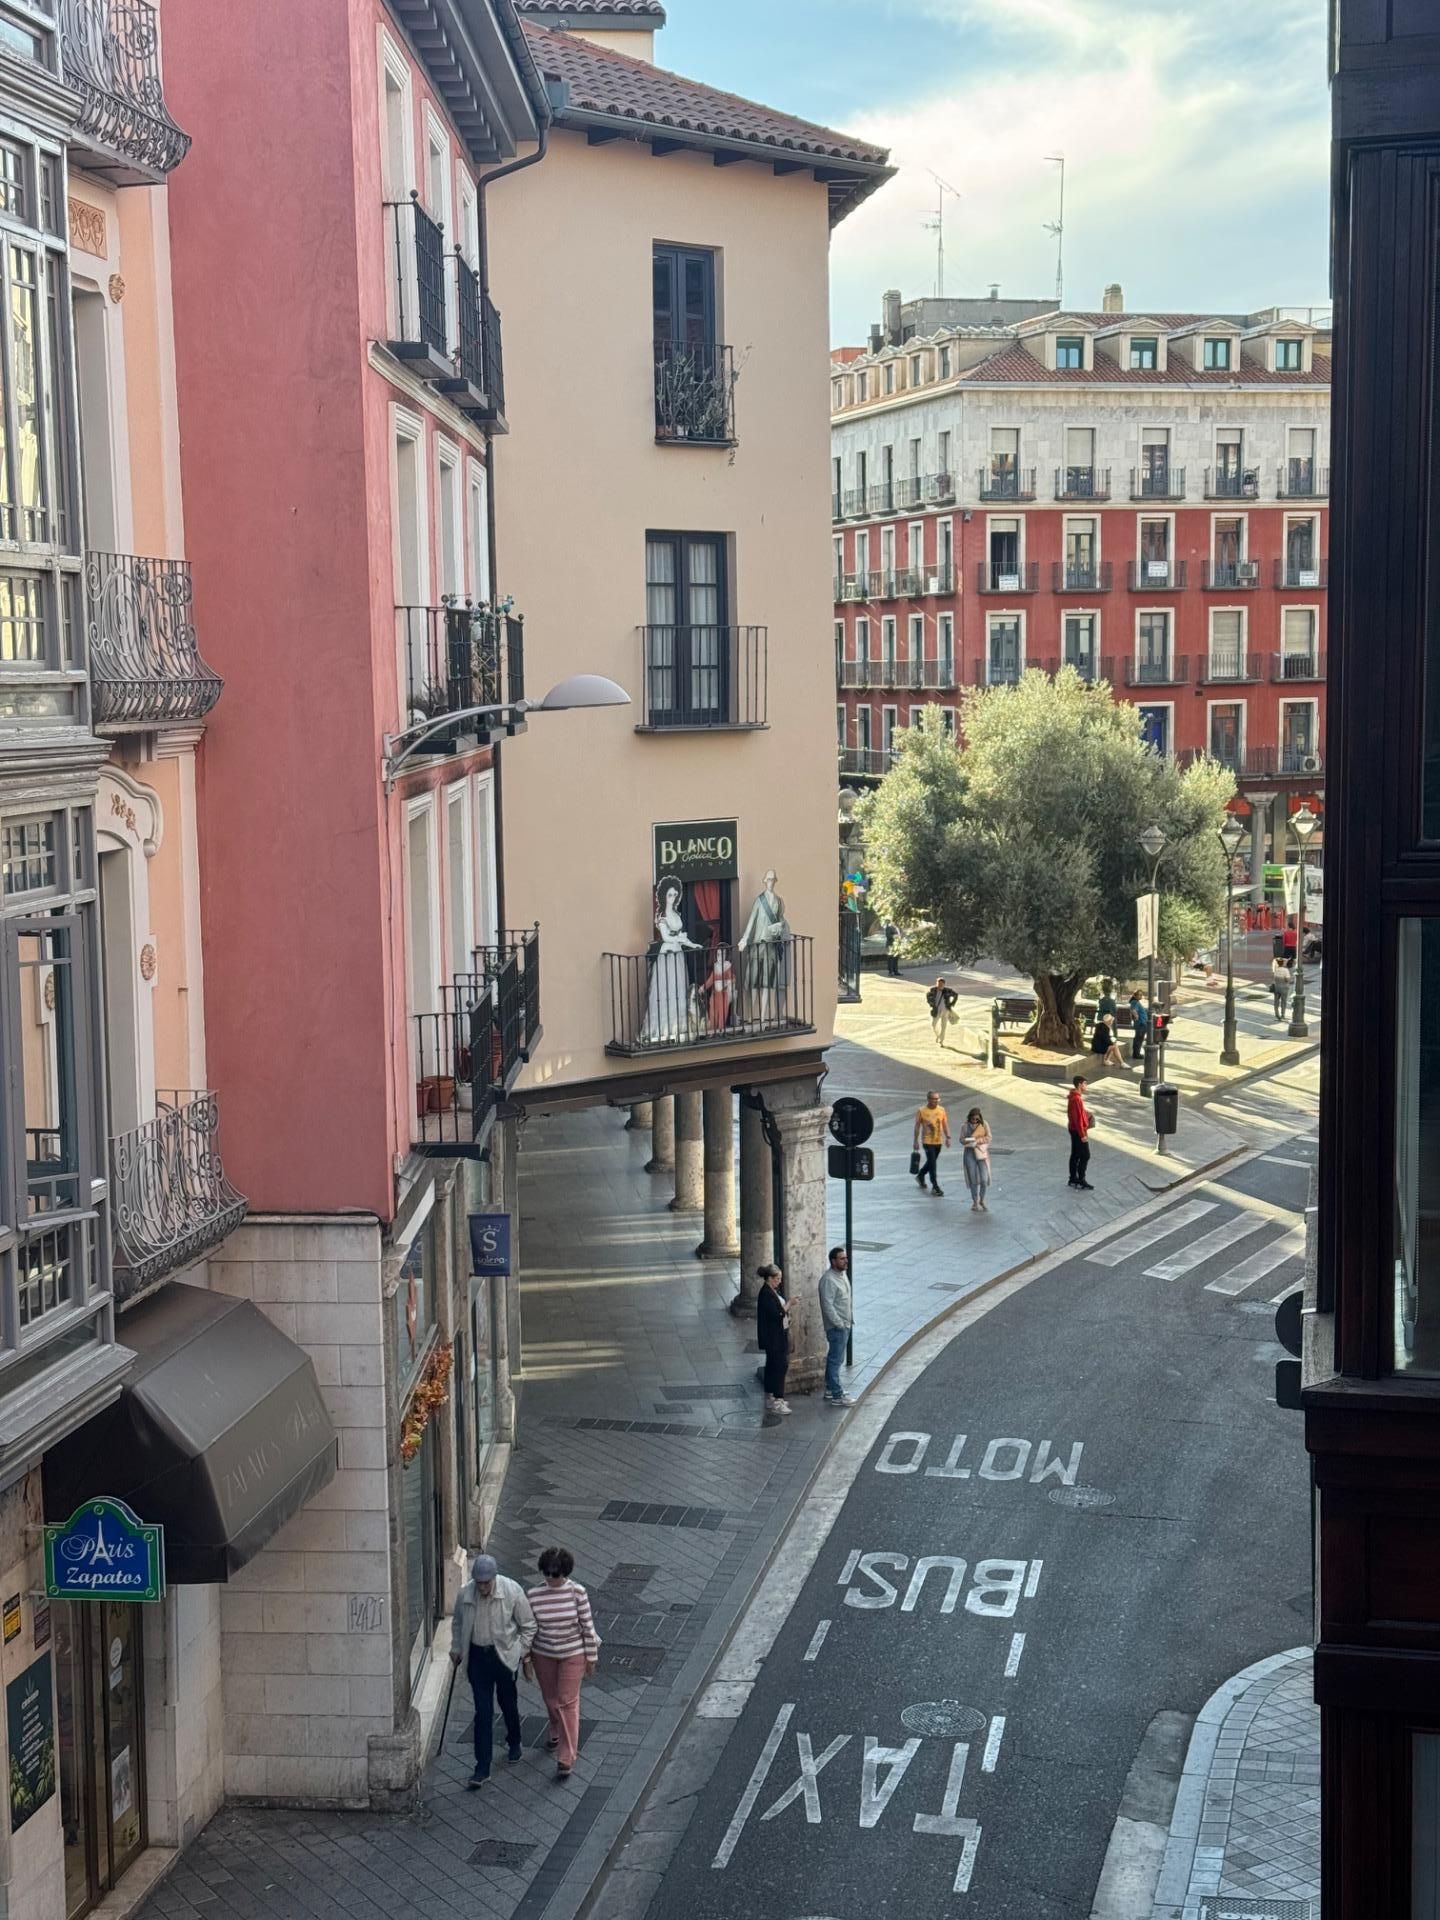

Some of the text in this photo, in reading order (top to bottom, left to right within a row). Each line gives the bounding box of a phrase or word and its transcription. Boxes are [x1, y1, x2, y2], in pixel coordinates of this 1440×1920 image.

[661, 836, 732, 865] BLANCO
[483, 1230, 497, 1252] S
[875, 1431, 1085, 1485] MOTO
[66, 1567, 142, 1589] Zapatos
[843, 1552, 1028, 1617] BUS
[715, 1708, 979, 1860] TAXI
